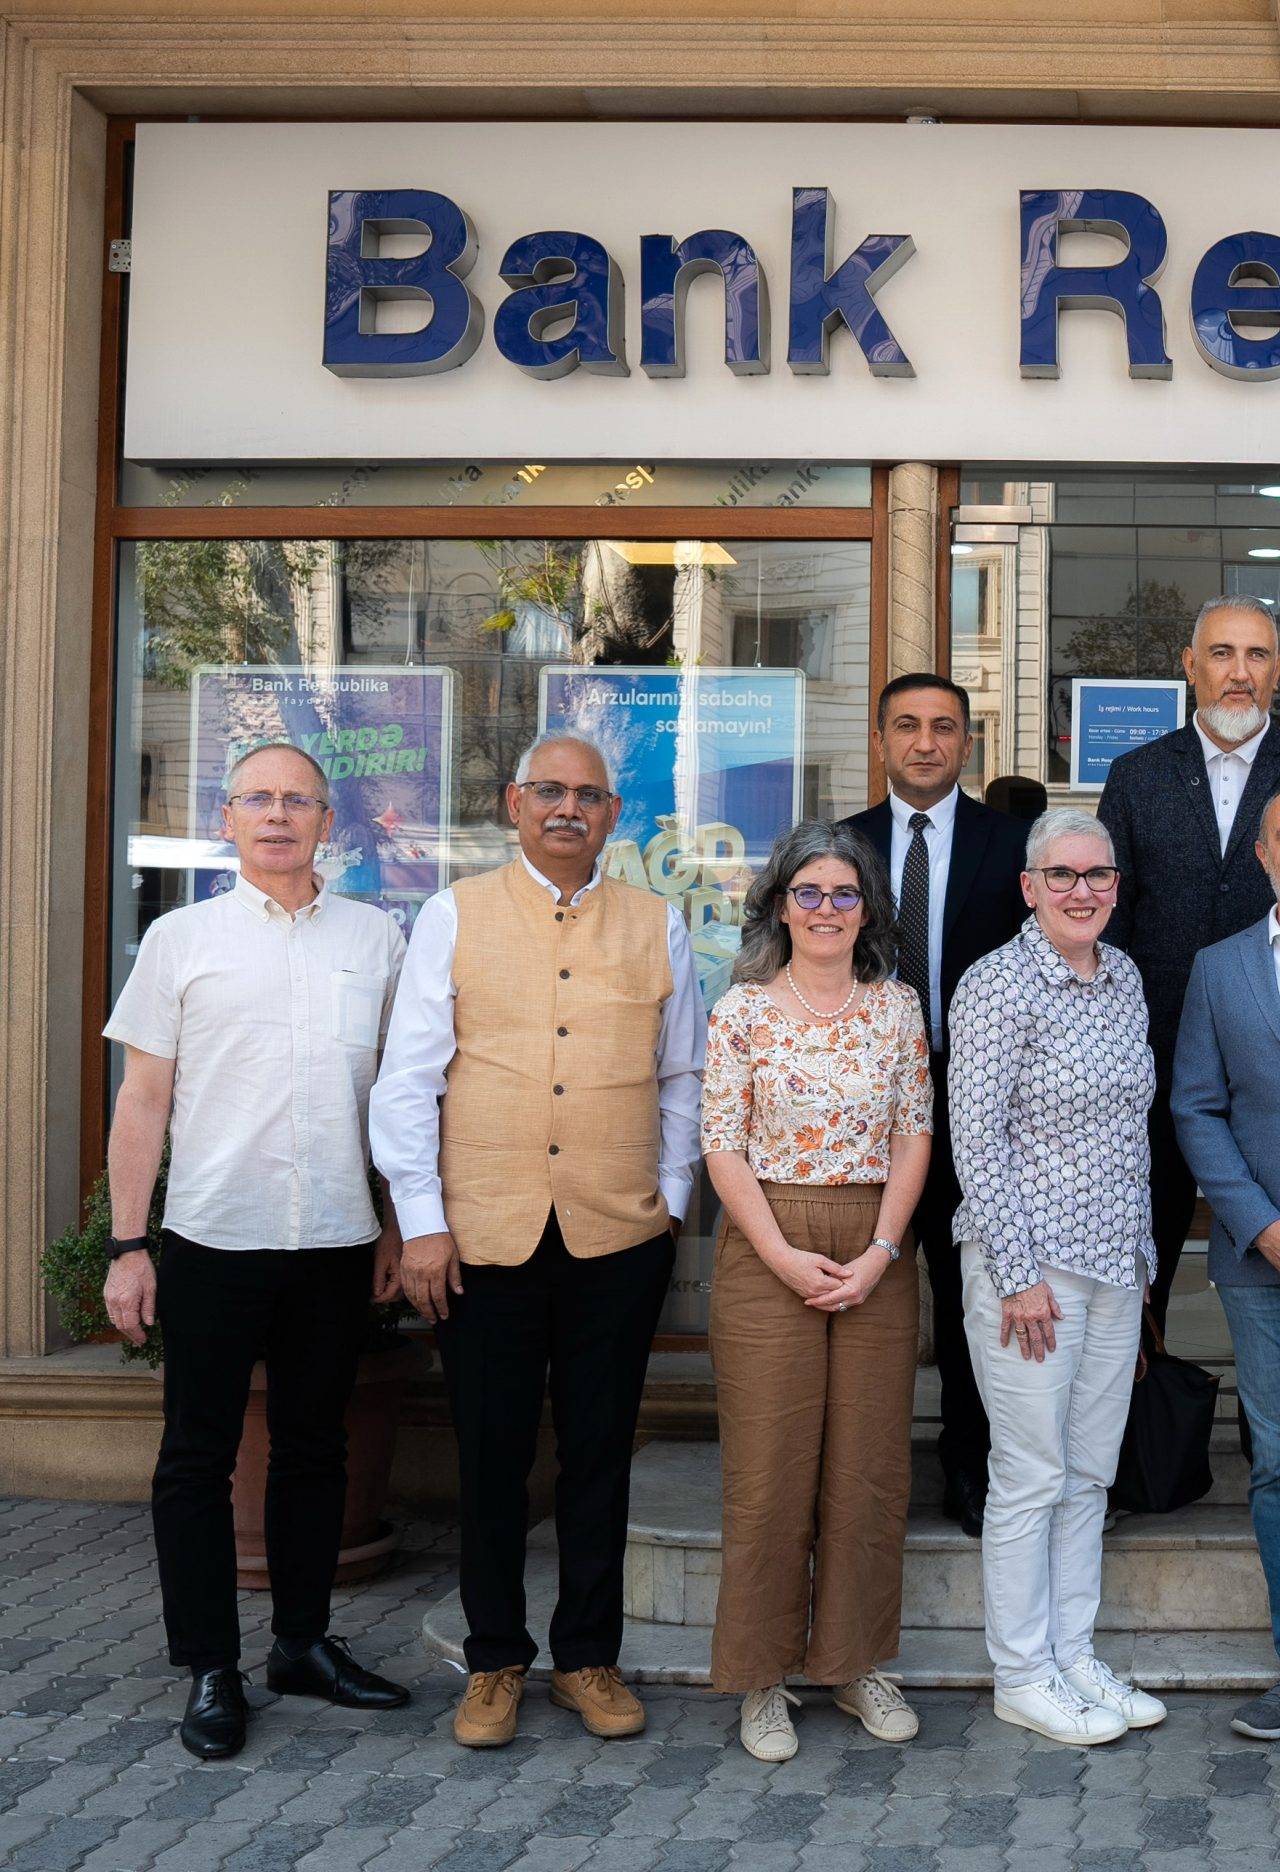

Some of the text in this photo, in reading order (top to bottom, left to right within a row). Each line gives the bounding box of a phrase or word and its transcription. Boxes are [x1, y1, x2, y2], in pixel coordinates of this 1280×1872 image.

[322, 186, 917, 381] Bank
[252, 678, 293, 692] Bank
[699, 690, 772, 707] sabaha
[1126, 705, 1142, 713] Work
[1143, 705, 1160, 713] hours
[655, 718, 772, 737] saamayın!
[603, 813, 746, 895] AĞD
